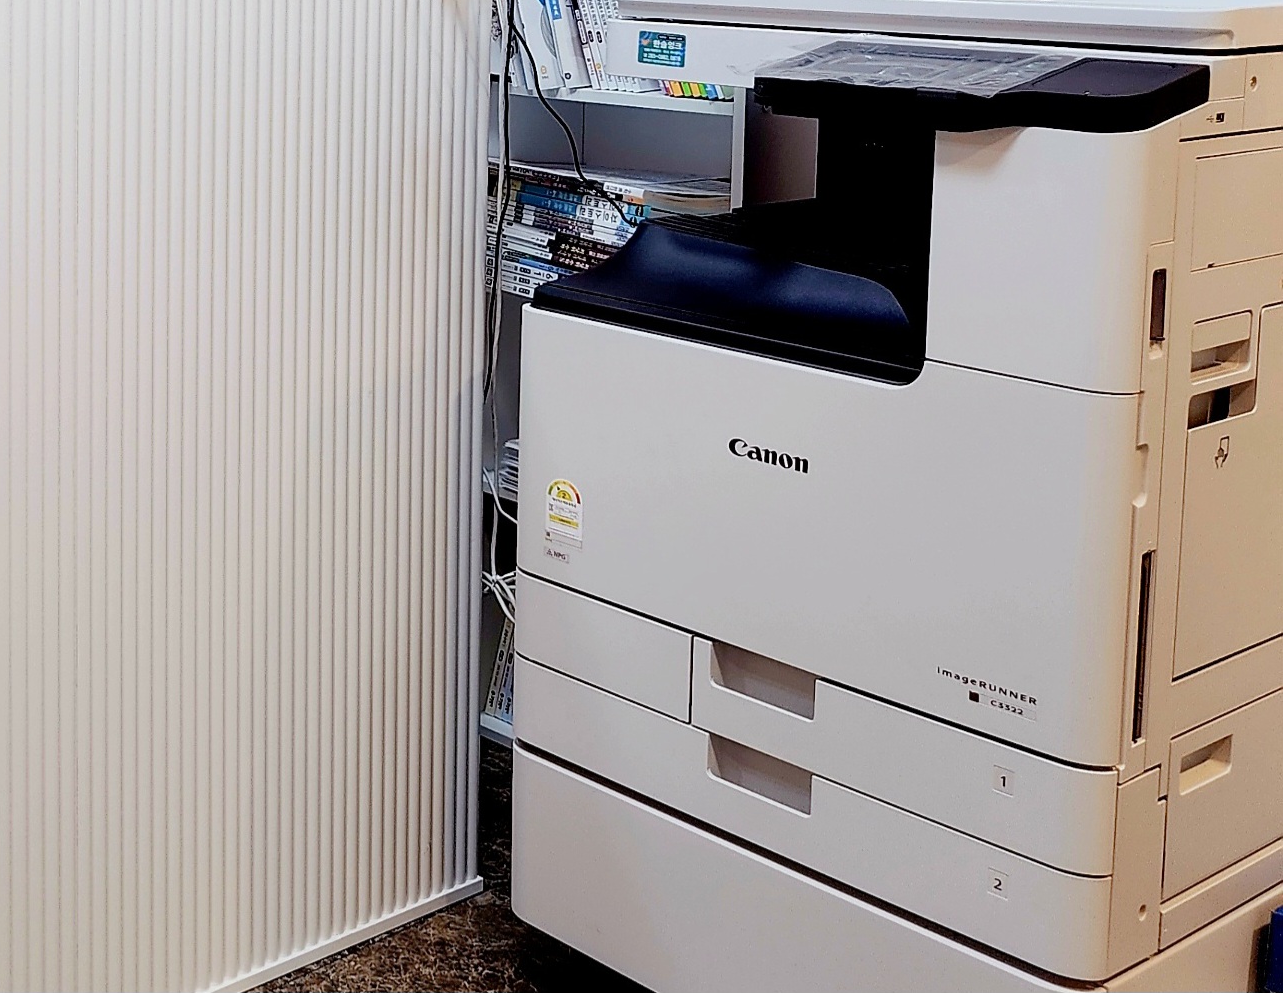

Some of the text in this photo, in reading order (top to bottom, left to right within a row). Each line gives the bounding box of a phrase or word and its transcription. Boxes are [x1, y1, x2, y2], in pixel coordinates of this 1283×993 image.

[728, 436, 810, 474] Canon
[937, 666, 1037, 705] imageRUNNER
[990, 699, 1024, 715] C3322
[999, 775, 1007, 787] 1
[994, 878, 1002, 891] 2
